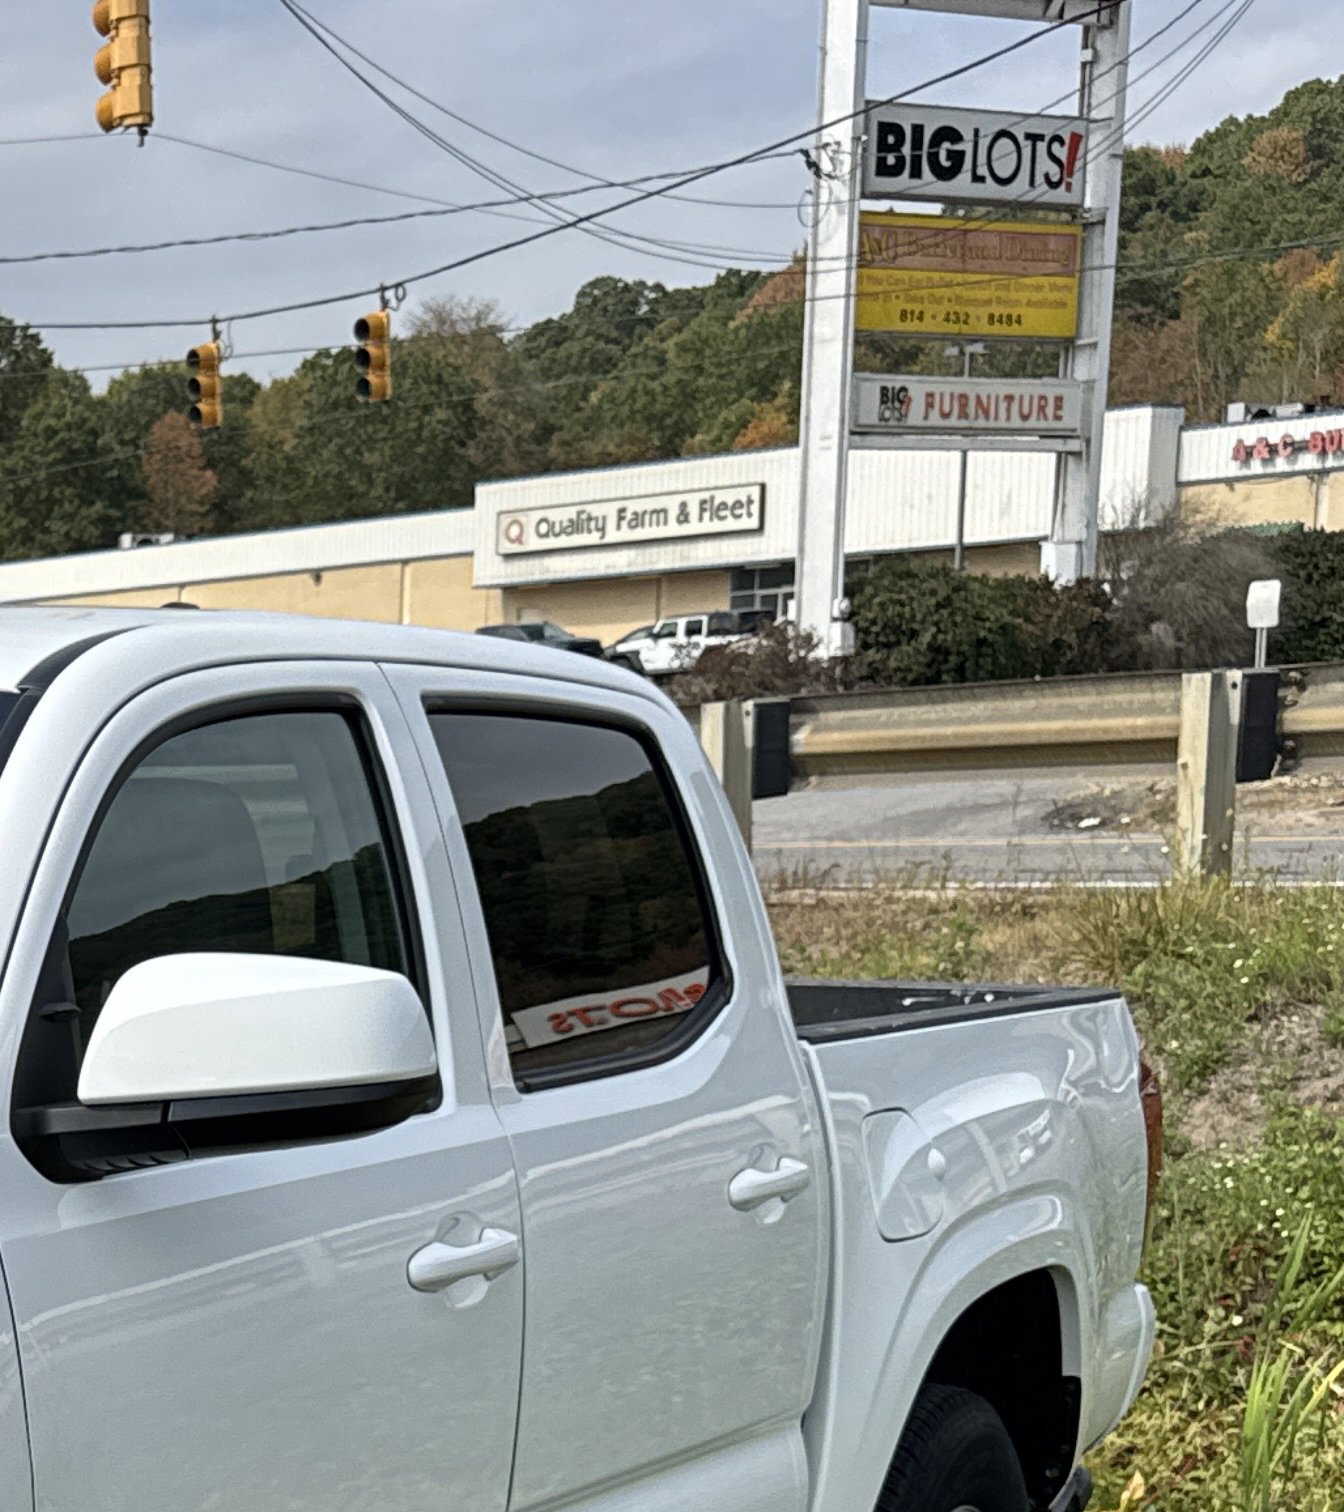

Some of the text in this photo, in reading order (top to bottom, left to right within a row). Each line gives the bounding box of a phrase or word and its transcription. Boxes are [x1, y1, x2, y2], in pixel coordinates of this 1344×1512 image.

[875, 121, 1084, 193] BIG LOTS!
[899, 309, 925, 323] 814
[943, 310, 970, 325] 432
[923, 391, 1065, 422] FURNITURE
[1308, 428, 1344, 455] BU
[535, 510, 606, 540] Quality
[615, 507, 669, 531] Farm
[676, 501, 690, 525] &
[697, 494, 755, 523] Fleet
